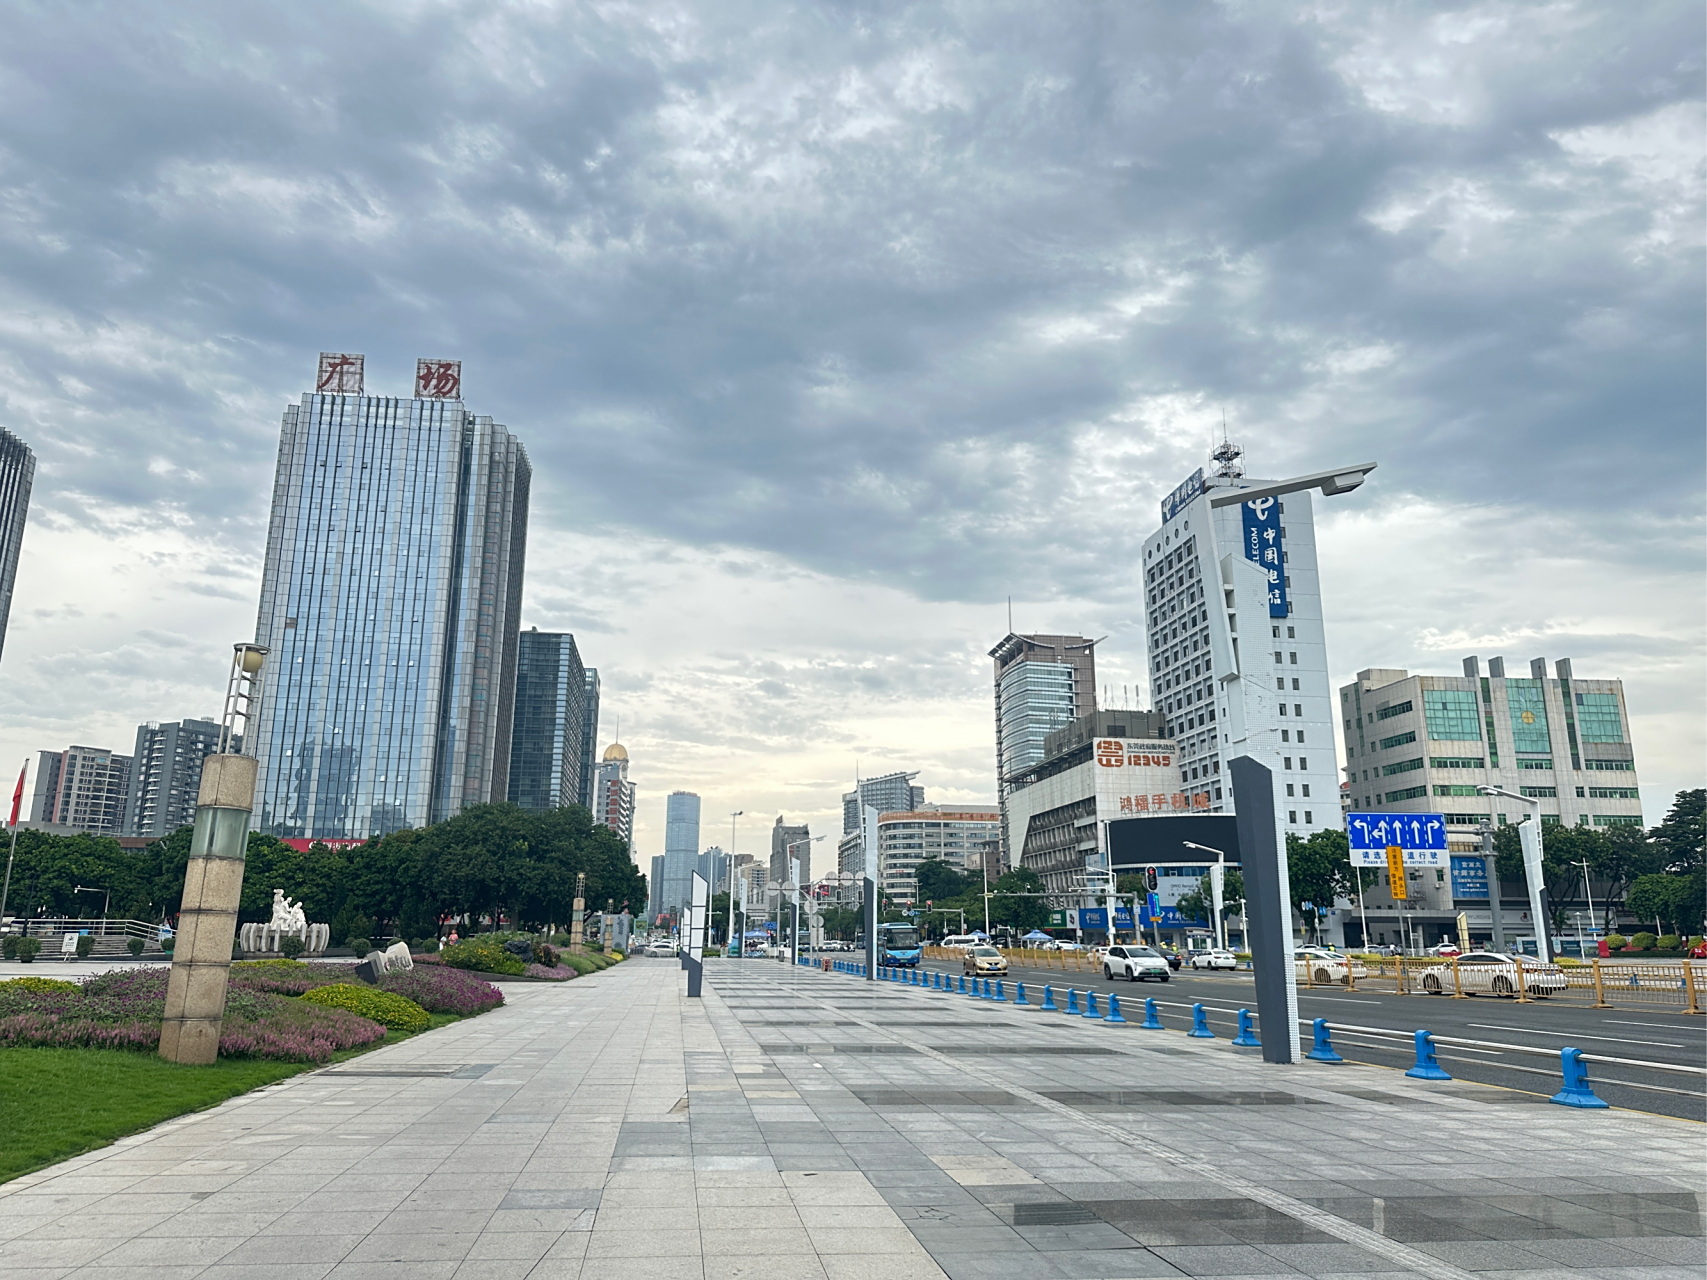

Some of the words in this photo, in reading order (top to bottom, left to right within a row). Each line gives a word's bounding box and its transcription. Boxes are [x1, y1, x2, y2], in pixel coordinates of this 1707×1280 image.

[1263, 526, 1282, 605] 中国电信
[1127, 755, 1171, 767] 12345
[1119, 792, 1211, 811] 鸿福手机城
[1362, 851, 1438, 860] 请选道行驶
